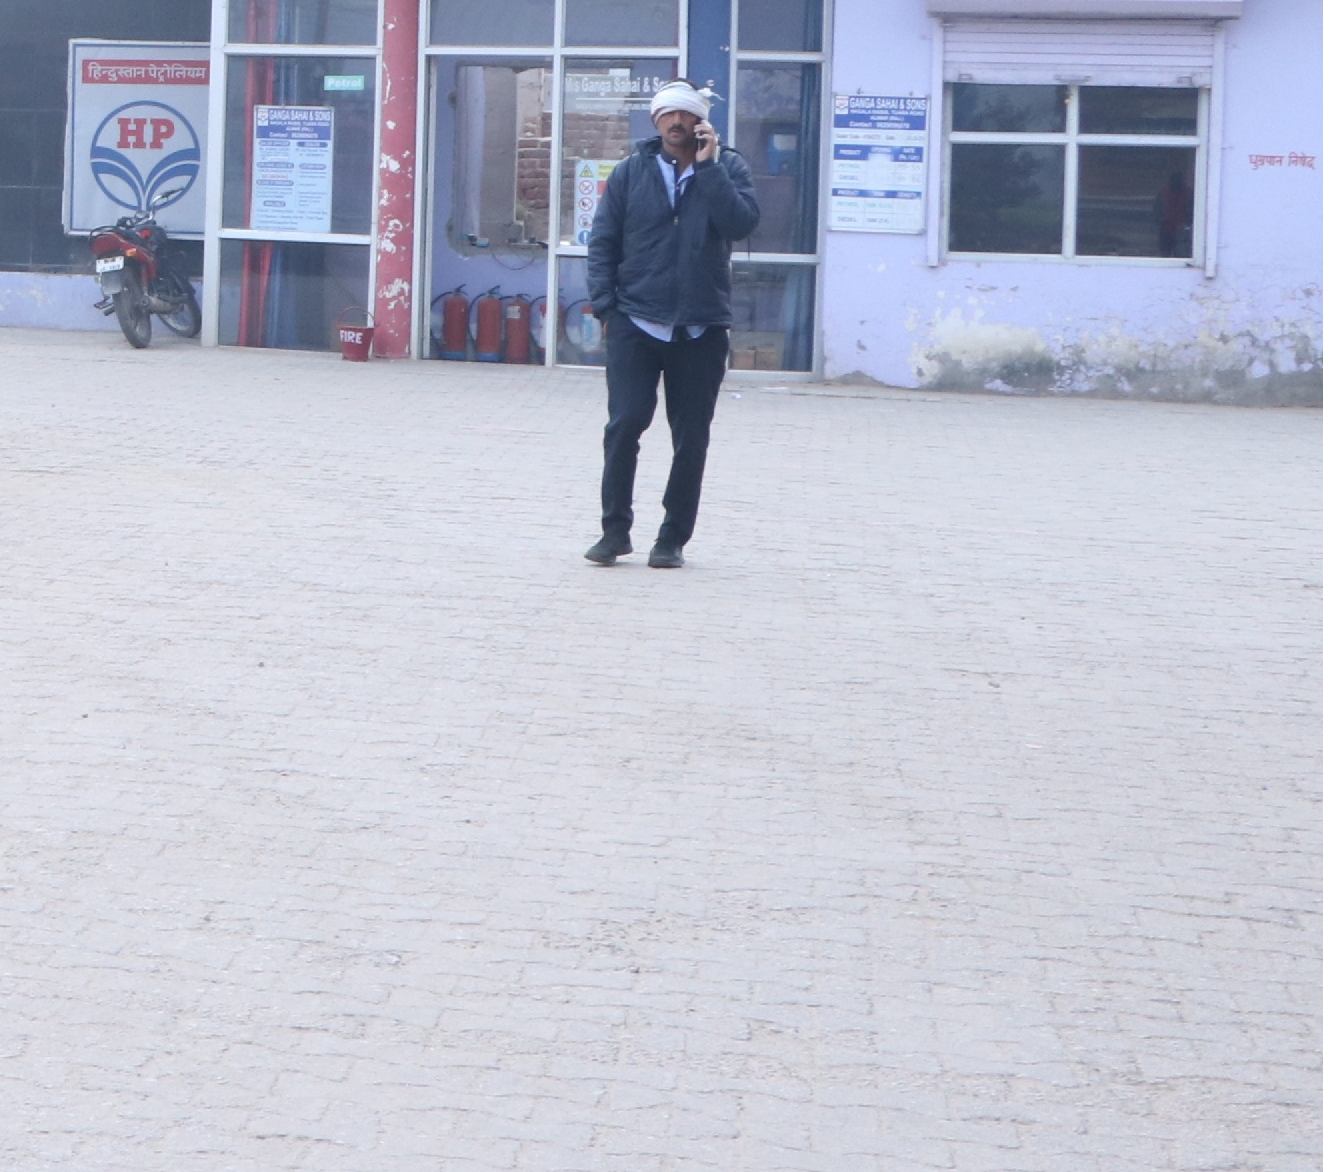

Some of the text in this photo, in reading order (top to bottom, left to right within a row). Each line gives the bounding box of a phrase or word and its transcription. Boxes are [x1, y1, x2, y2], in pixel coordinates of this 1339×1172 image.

[88, 62, 206, 82] हिन्दुस्तान पेट्रोलियम
[328, 78, 362, 87] Petrol
[581, 77, 611, 96] Ganga
[614, 77, 641, 93] Sahai
[643, 77, 651, 93] &
[849, 97, 926, 110] GANGA SAHAI & SONS
[269, 110, 291, 120] GANGA
[291, 110, 309, 120] SAHAI
[315, 111, 331, 121] SONS
[117, 118, 175, 149] HP
[339, 329, 363, 345] FIRE
